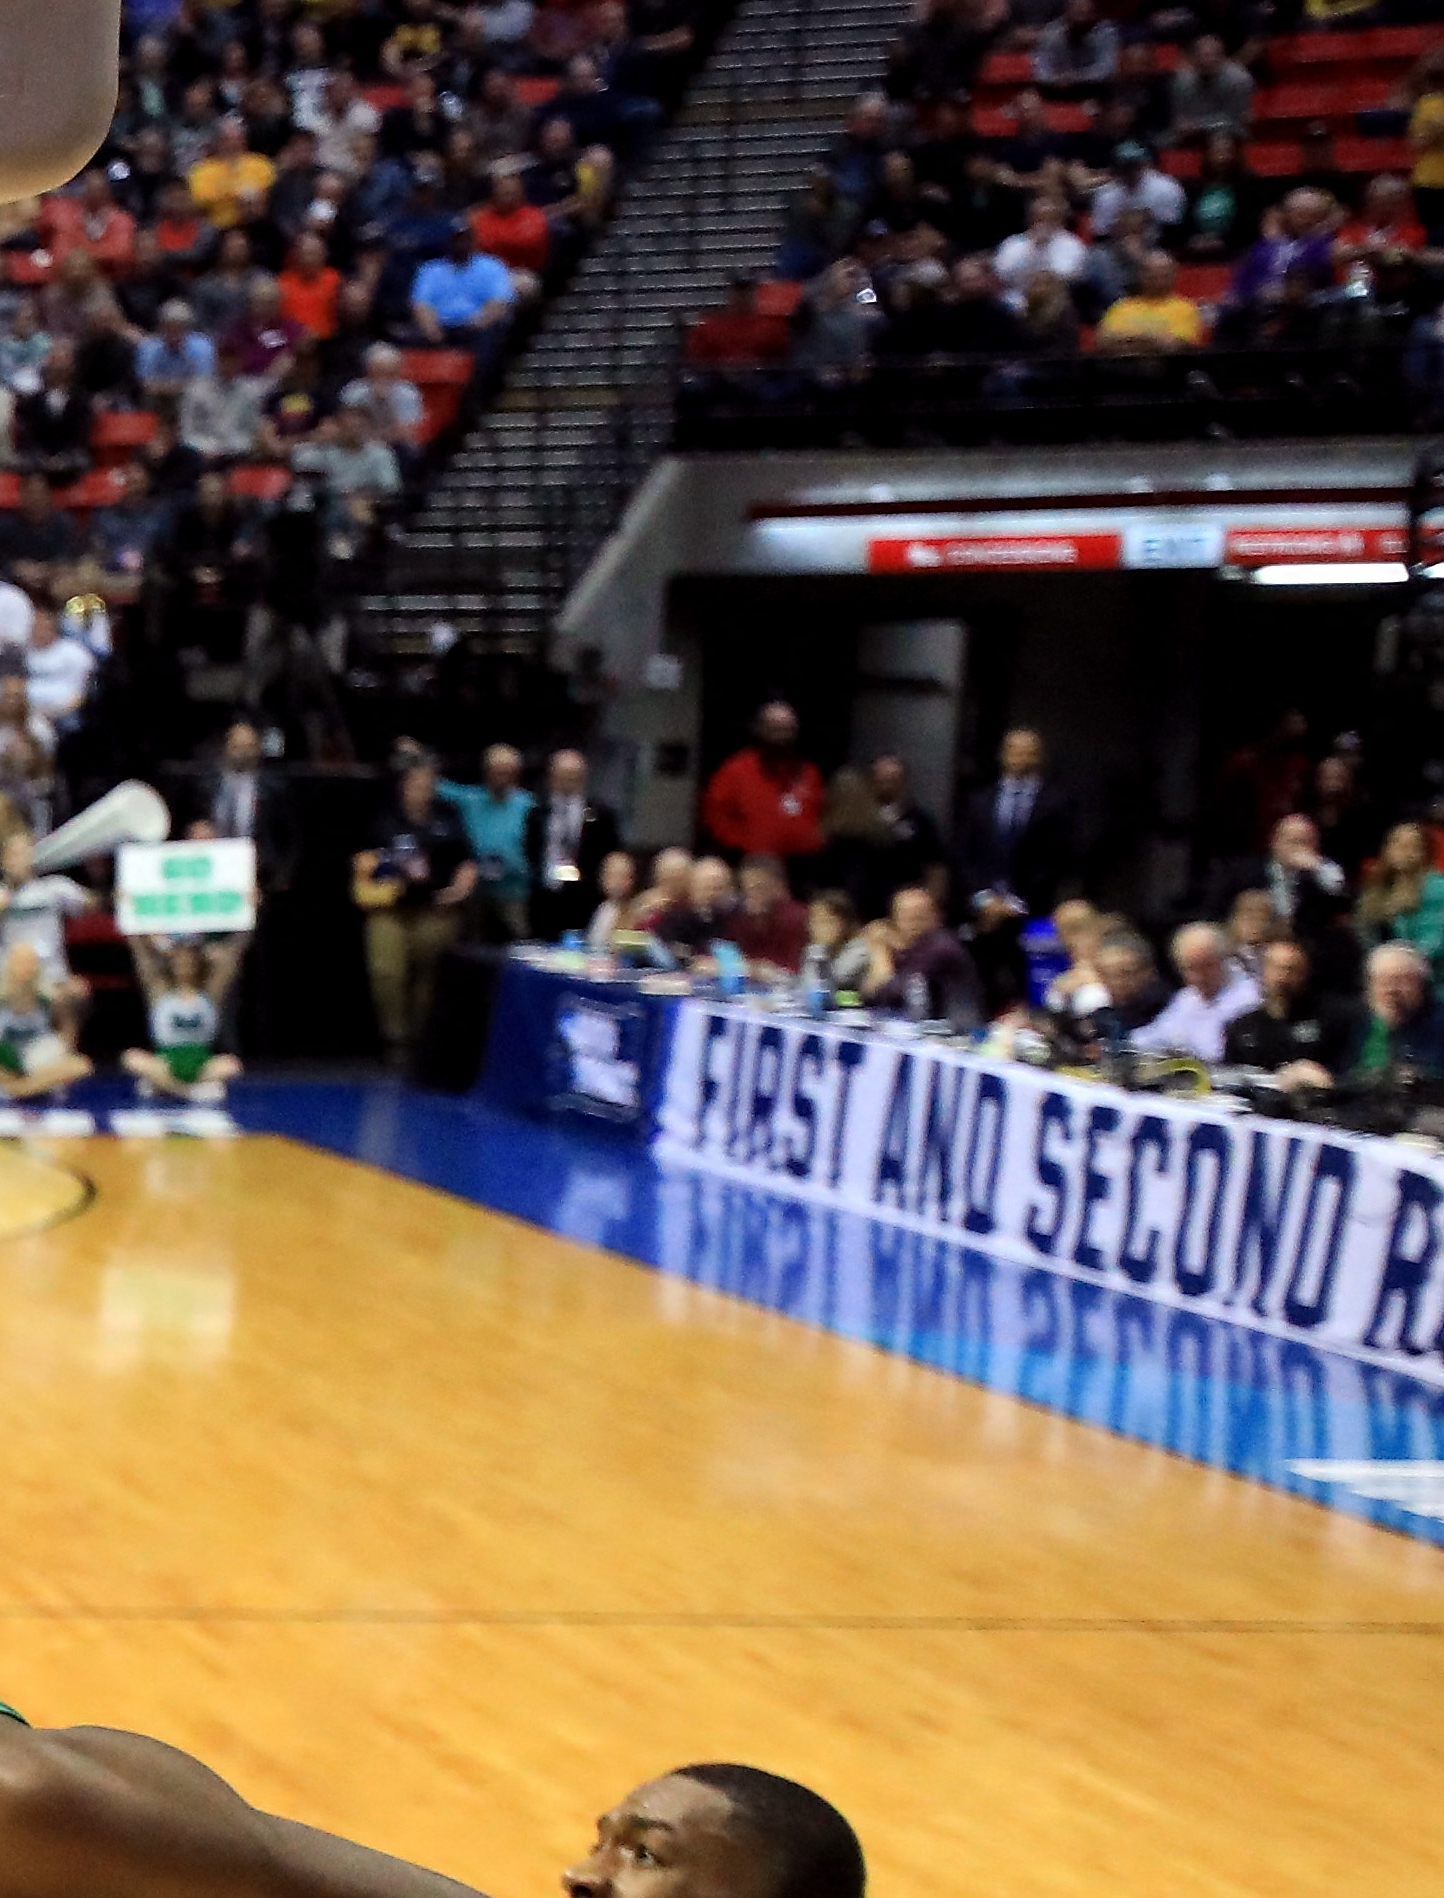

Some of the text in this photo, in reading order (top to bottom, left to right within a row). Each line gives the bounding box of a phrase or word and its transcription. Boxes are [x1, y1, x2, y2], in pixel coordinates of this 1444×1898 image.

[692, 1013, 867, 1188] FIRST
[874, 1051, 1009, 1233] AND
[1025, 1090, 1356, 1328] SECOND
